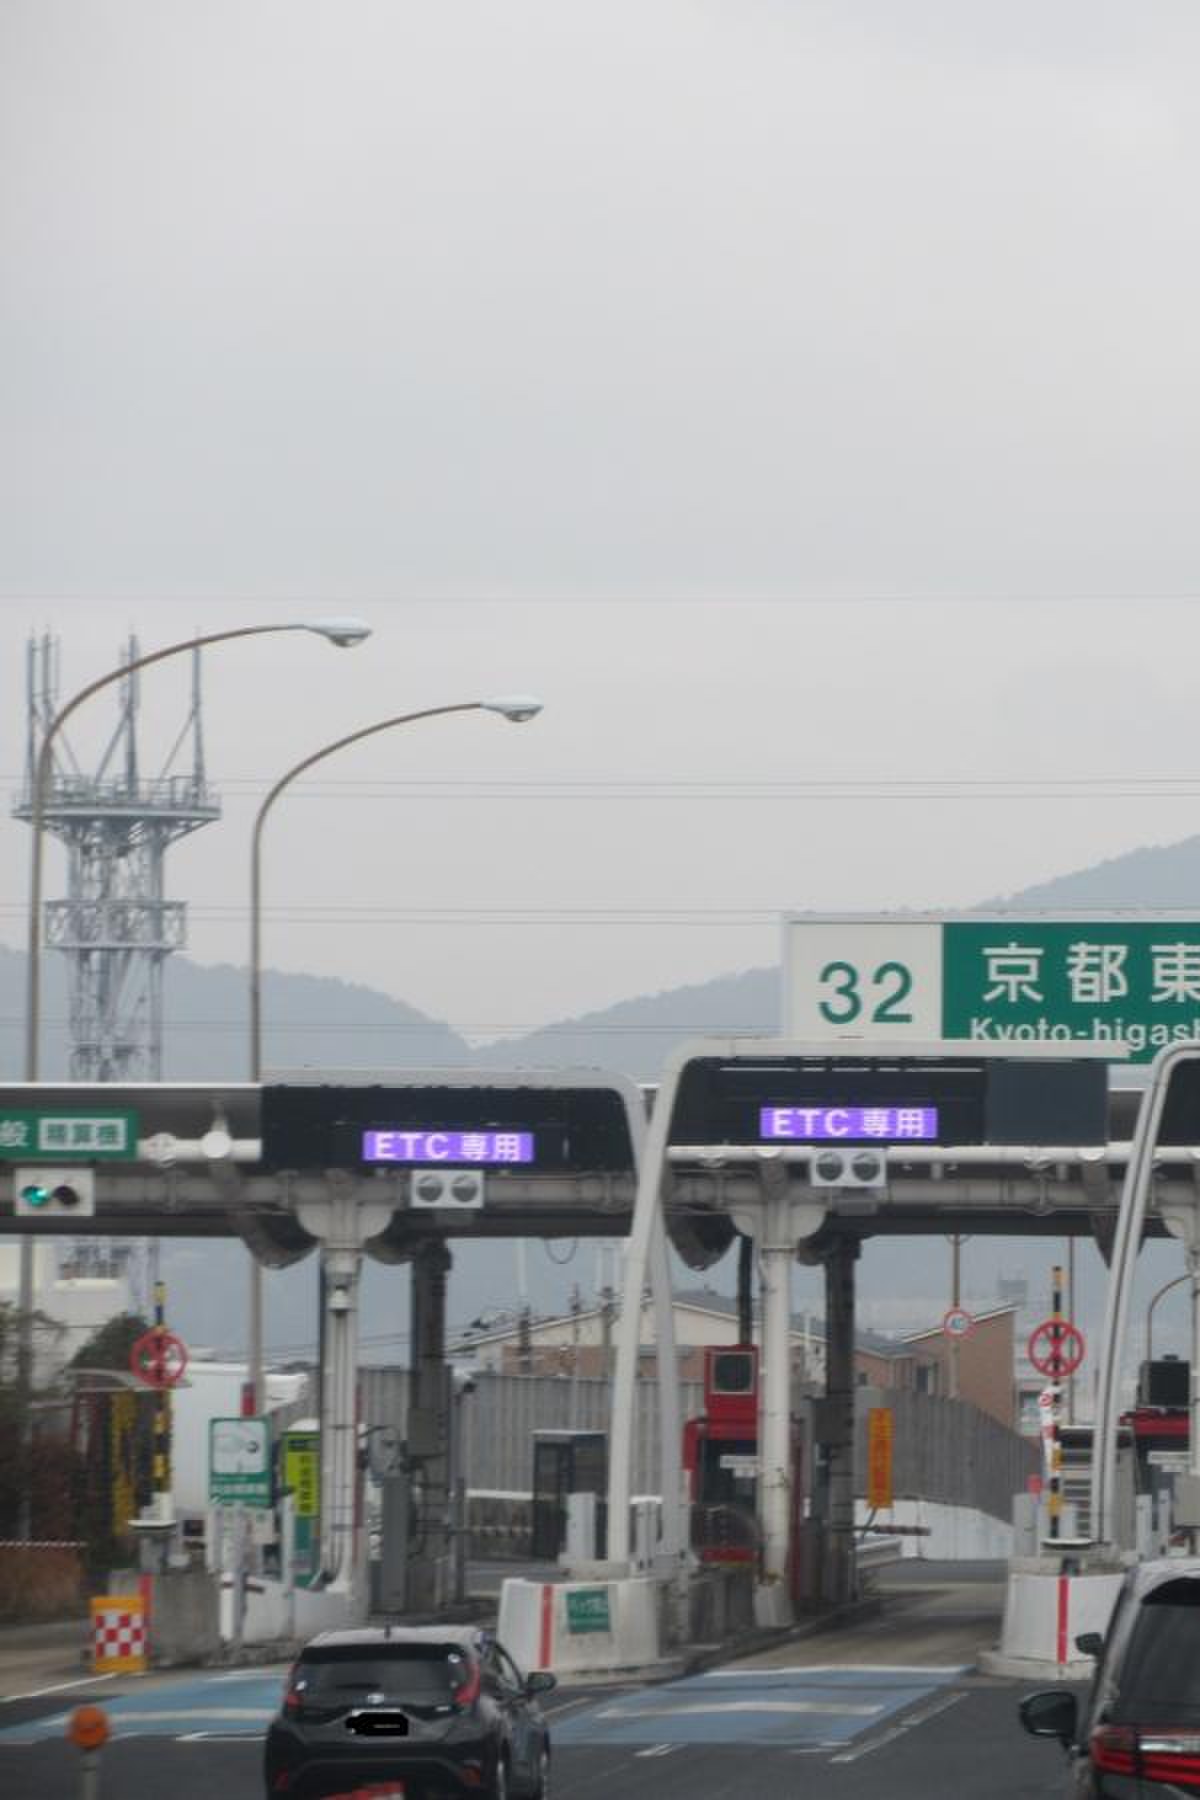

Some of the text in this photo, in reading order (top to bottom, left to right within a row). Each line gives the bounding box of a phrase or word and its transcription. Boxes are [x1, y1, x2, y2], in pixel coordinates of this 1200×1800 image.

[817, 960, 914, 1025] 32
[773, 1109, 924, 1138] ETC 専用
[374, 1133, 521, 1161] ETC 専用
